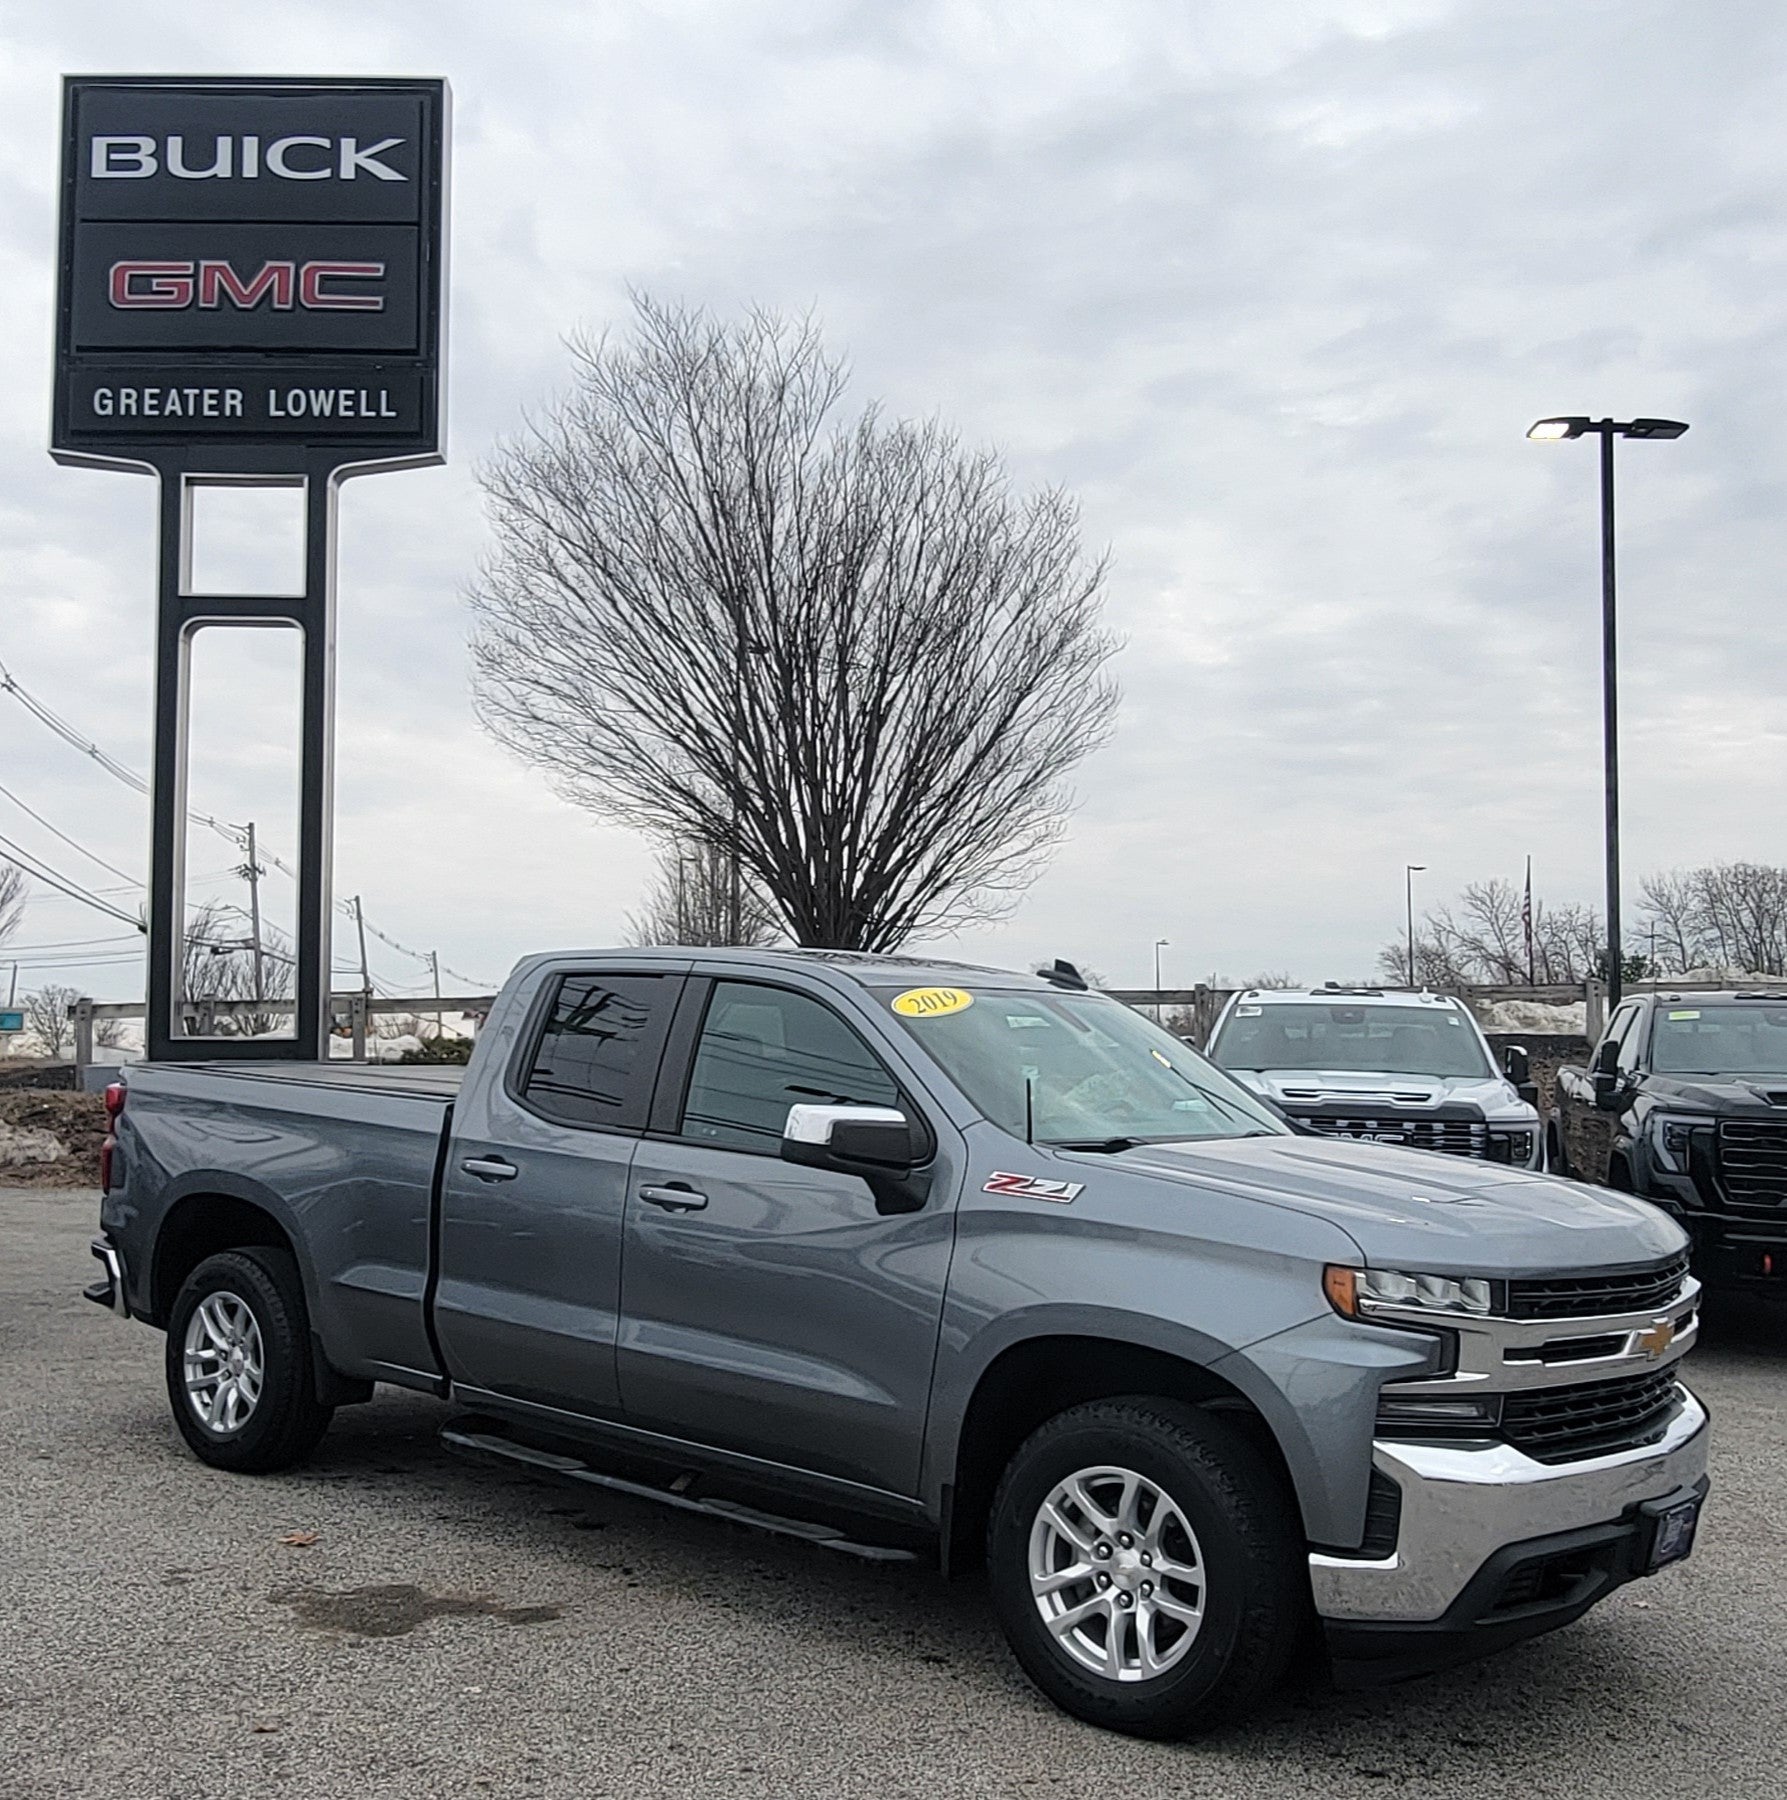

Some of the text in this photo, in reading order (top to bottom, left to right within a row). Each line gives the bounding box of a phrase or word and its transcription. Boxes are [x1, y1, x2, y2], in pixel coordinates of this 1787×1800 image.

[90, 135, 409, 182] BUICK
[109, 260, 386, 311] GMC
[93, 387, 398, 419] GREATER LOWELL
[908, 990, 958, 1014] 2019
[982, 1170, 1085, 1204] Z71
